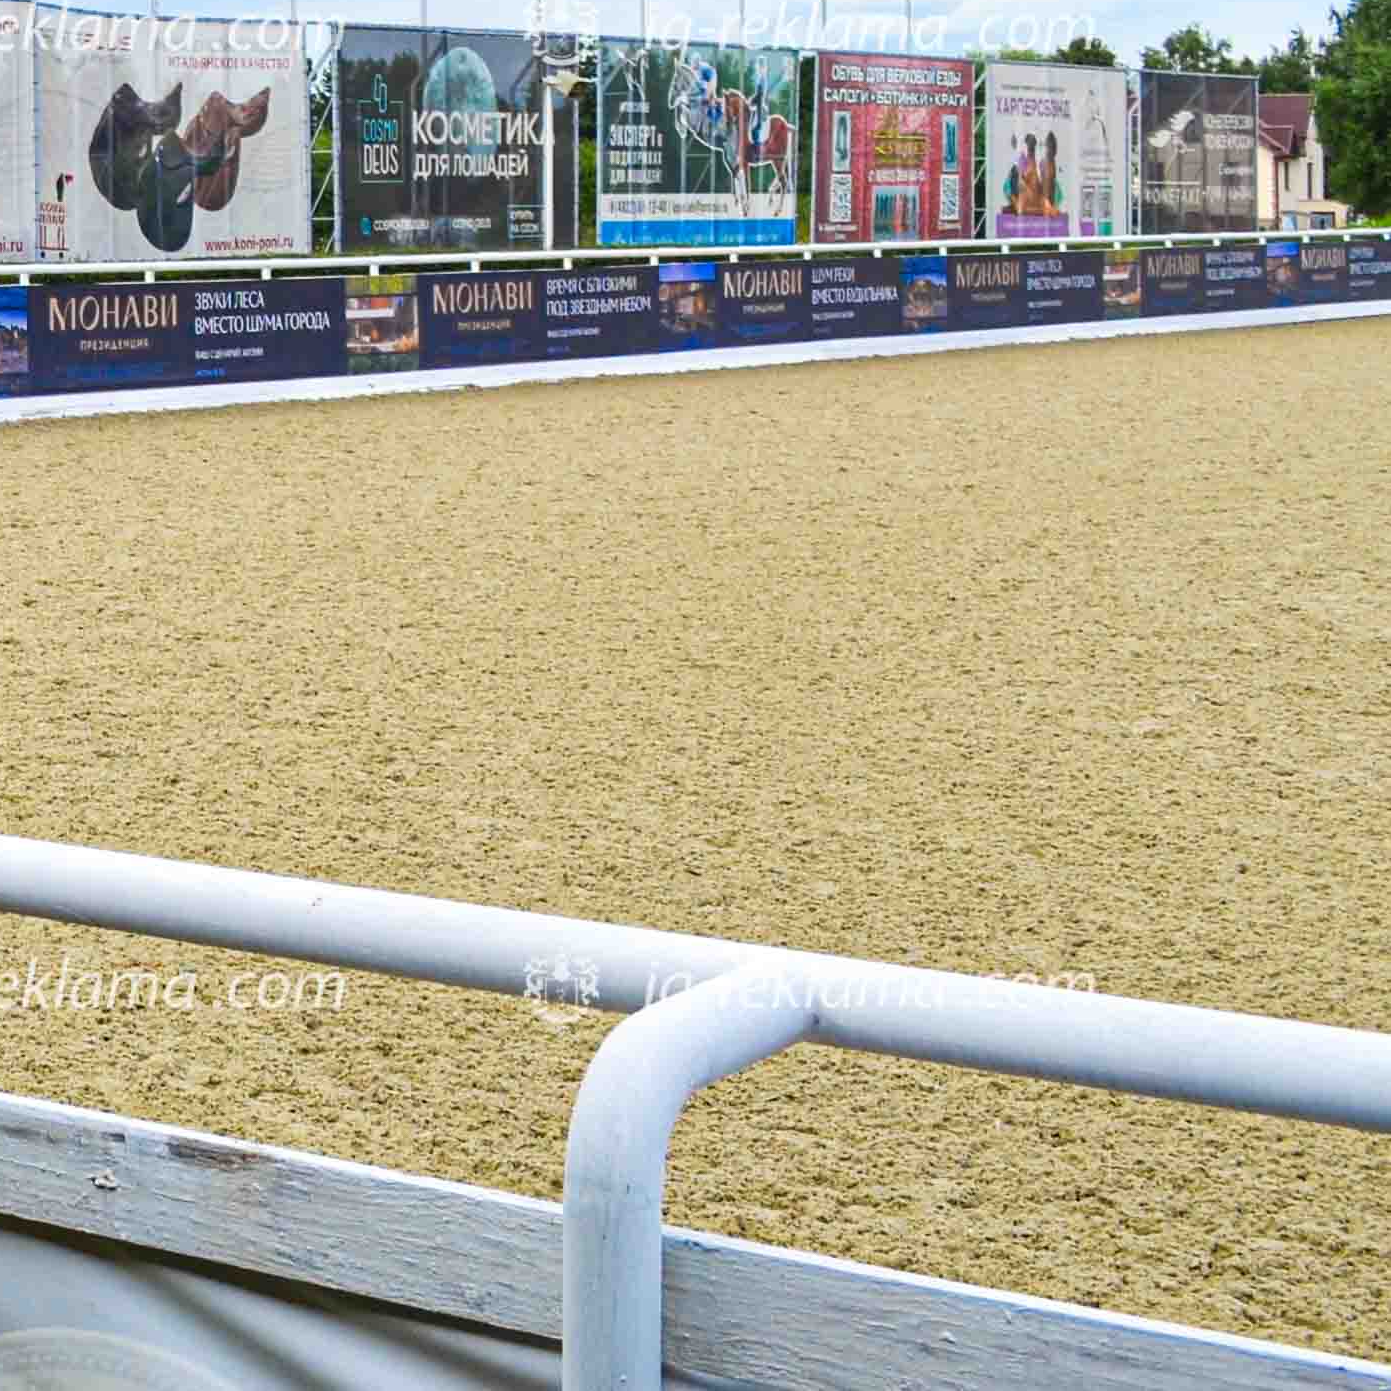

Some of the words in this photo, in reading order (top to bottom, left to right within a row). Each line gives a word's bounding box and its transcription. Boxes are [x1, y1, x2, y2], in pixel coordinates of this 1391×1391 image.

[362, 118, 399, 143] COSMO
[362, 143, 400, 176] DEUS
[413, 153, 450, 182] ДЛЯ
[452, 149, 530, 180] ЛОШАДЕЙ
[204, 235, 294, 255] www.koni-poni.ru
[49, 295, 179, 332] МОНАВИ
[194, 292, 232, 311] ЗВУКИ
[234, 290, 265, 308] ЛЕСА
[433, 282, 532, 315] МОНАВИ
[194, 315, 244, 336] ВМЕСТО
[246, 312, 283, 333] ШУМА
[285, 309, 331, 332] ГОРОДА
